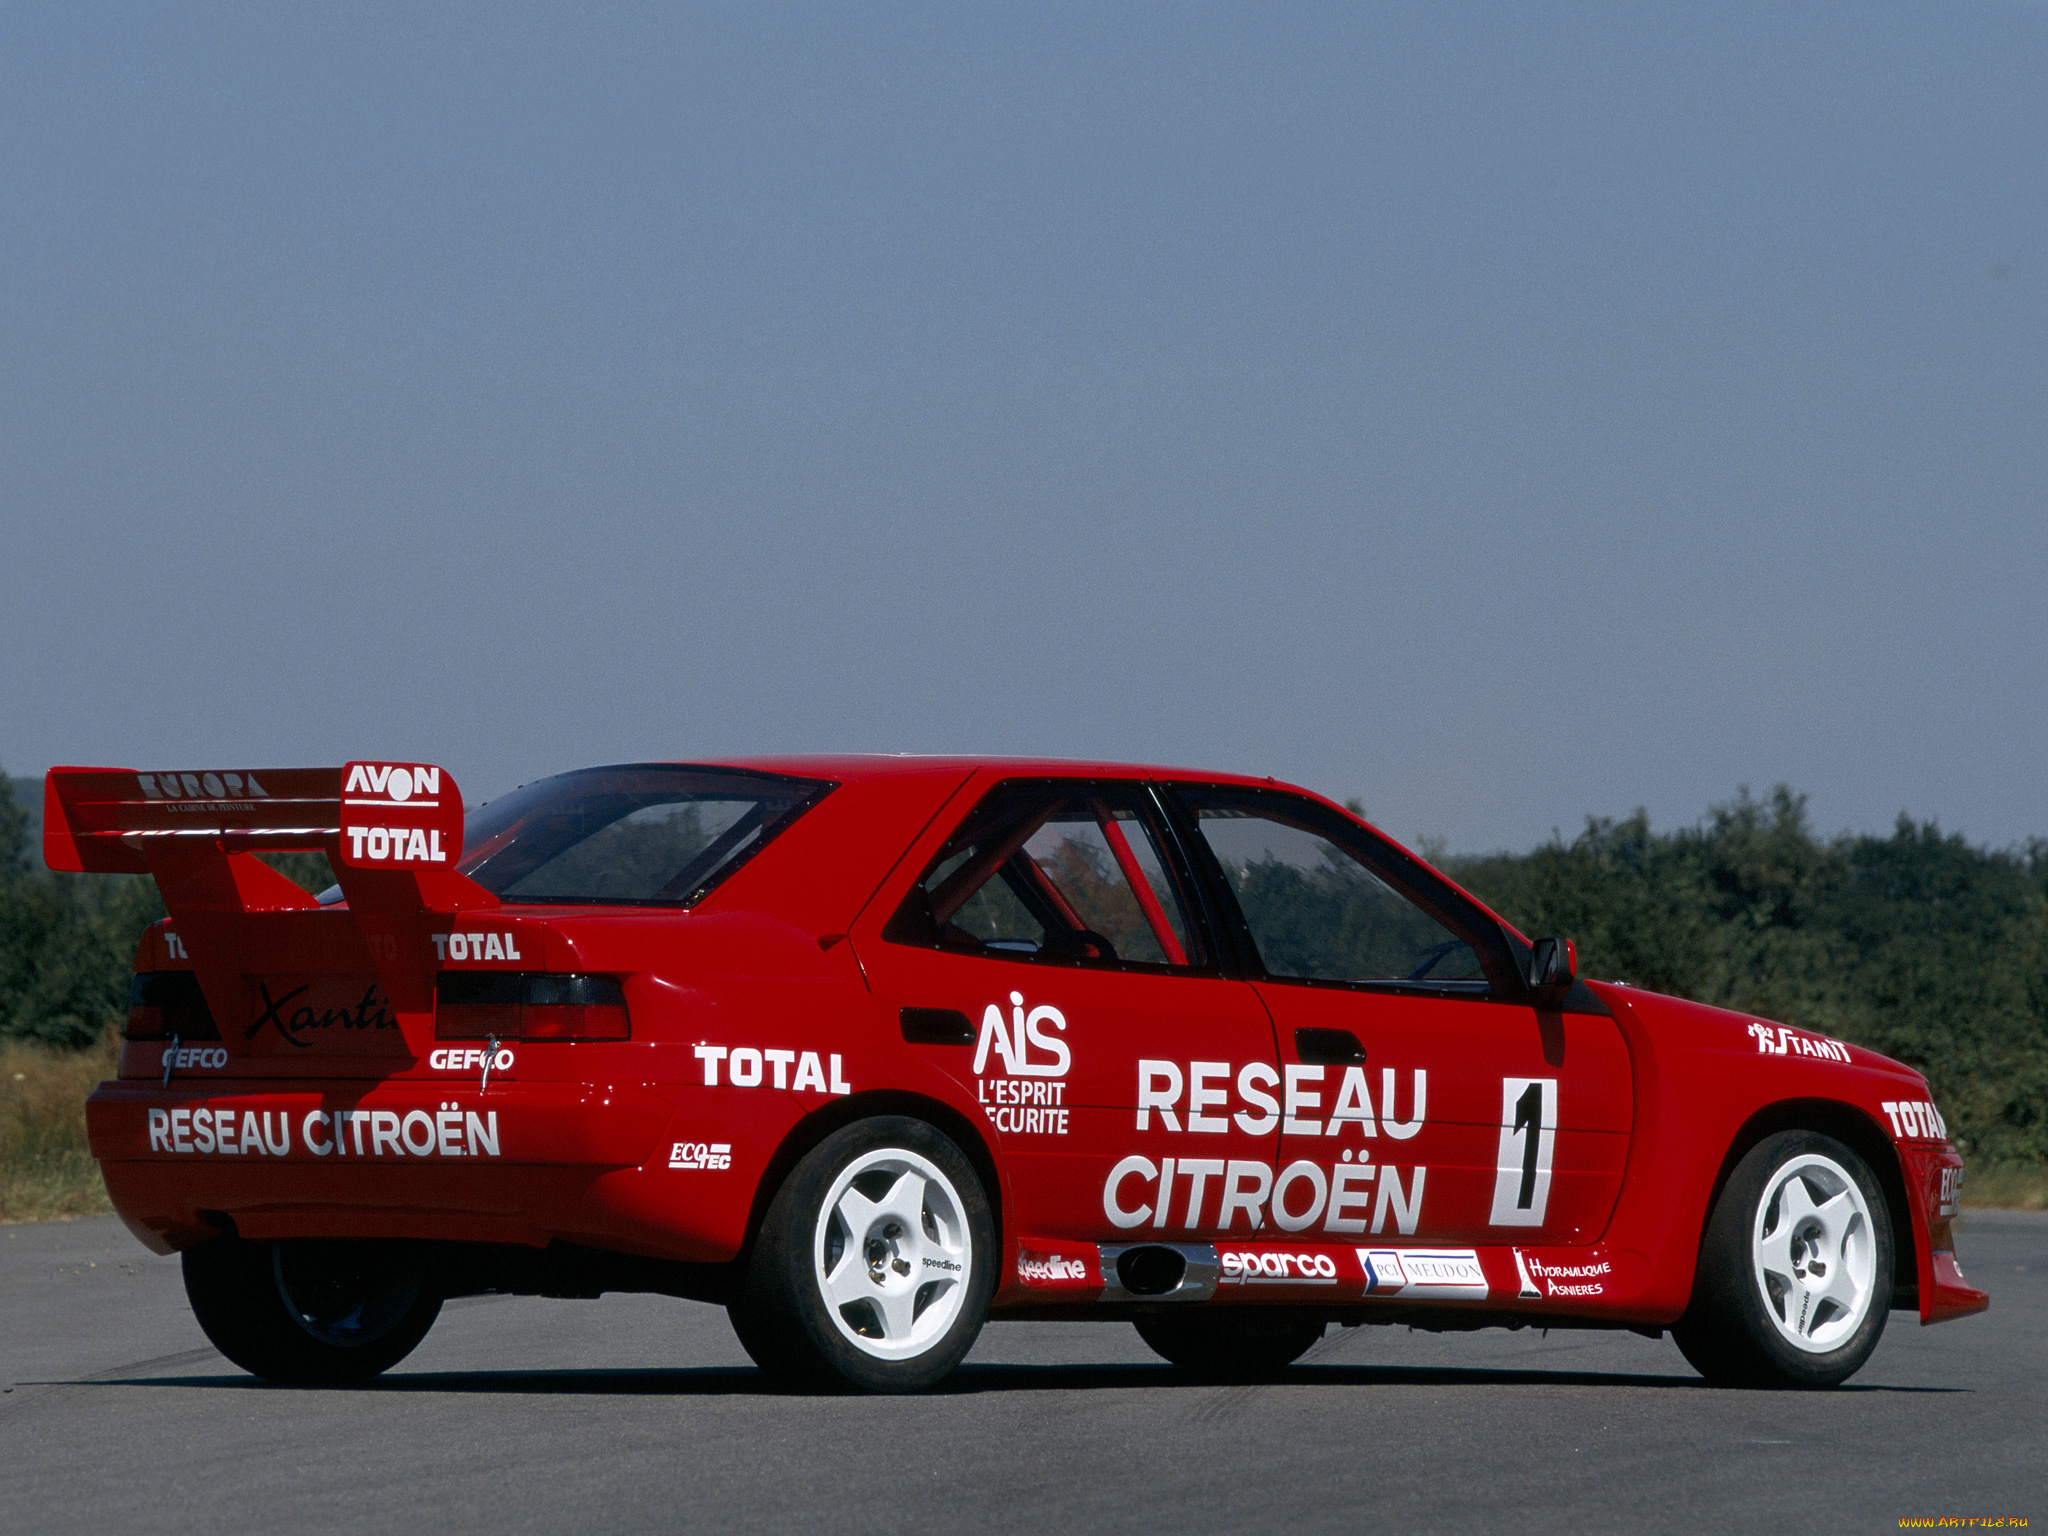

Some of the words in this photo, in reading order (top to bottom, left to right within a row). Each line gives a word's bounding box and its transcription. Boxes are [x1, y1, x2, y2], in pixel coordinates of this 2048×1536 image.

[137, 772, 270, 798] EUROPA
[345, 765, 439, 801] AVON
[347, 826, 446, 862] TOTAL
[431, 933, 520, 960] TOTAL
[692, 1046, 850, 1095] TOTAL
[978, 1079, 1066, 1106] L'ESPRIT
[1135, 1059, 1427, 1140] RESEAU
[149, 1108, 290, 1155] RESEAU
[303, 1102, 500, 1156] CITROËN
[985, 1107, 1069, 1134] ECURITE
[670, 1143, 708, 1161] ECO
[1513, 1083, 1542, 1209] 1
[698, 1154, 731, 1169] TEC
[1103, 1149, 1427, 1235] CITROËN
[922, 1257, 962, 1271] speedline
[1220, 1252, 1338, 1285] sparco
[1407, 1263, 1481, 1278] MEUDON
[1529, 1258, 1612, 1277] HYDRAULIQUE
[1547, 1278, 1603, 1296] ASNIERES
